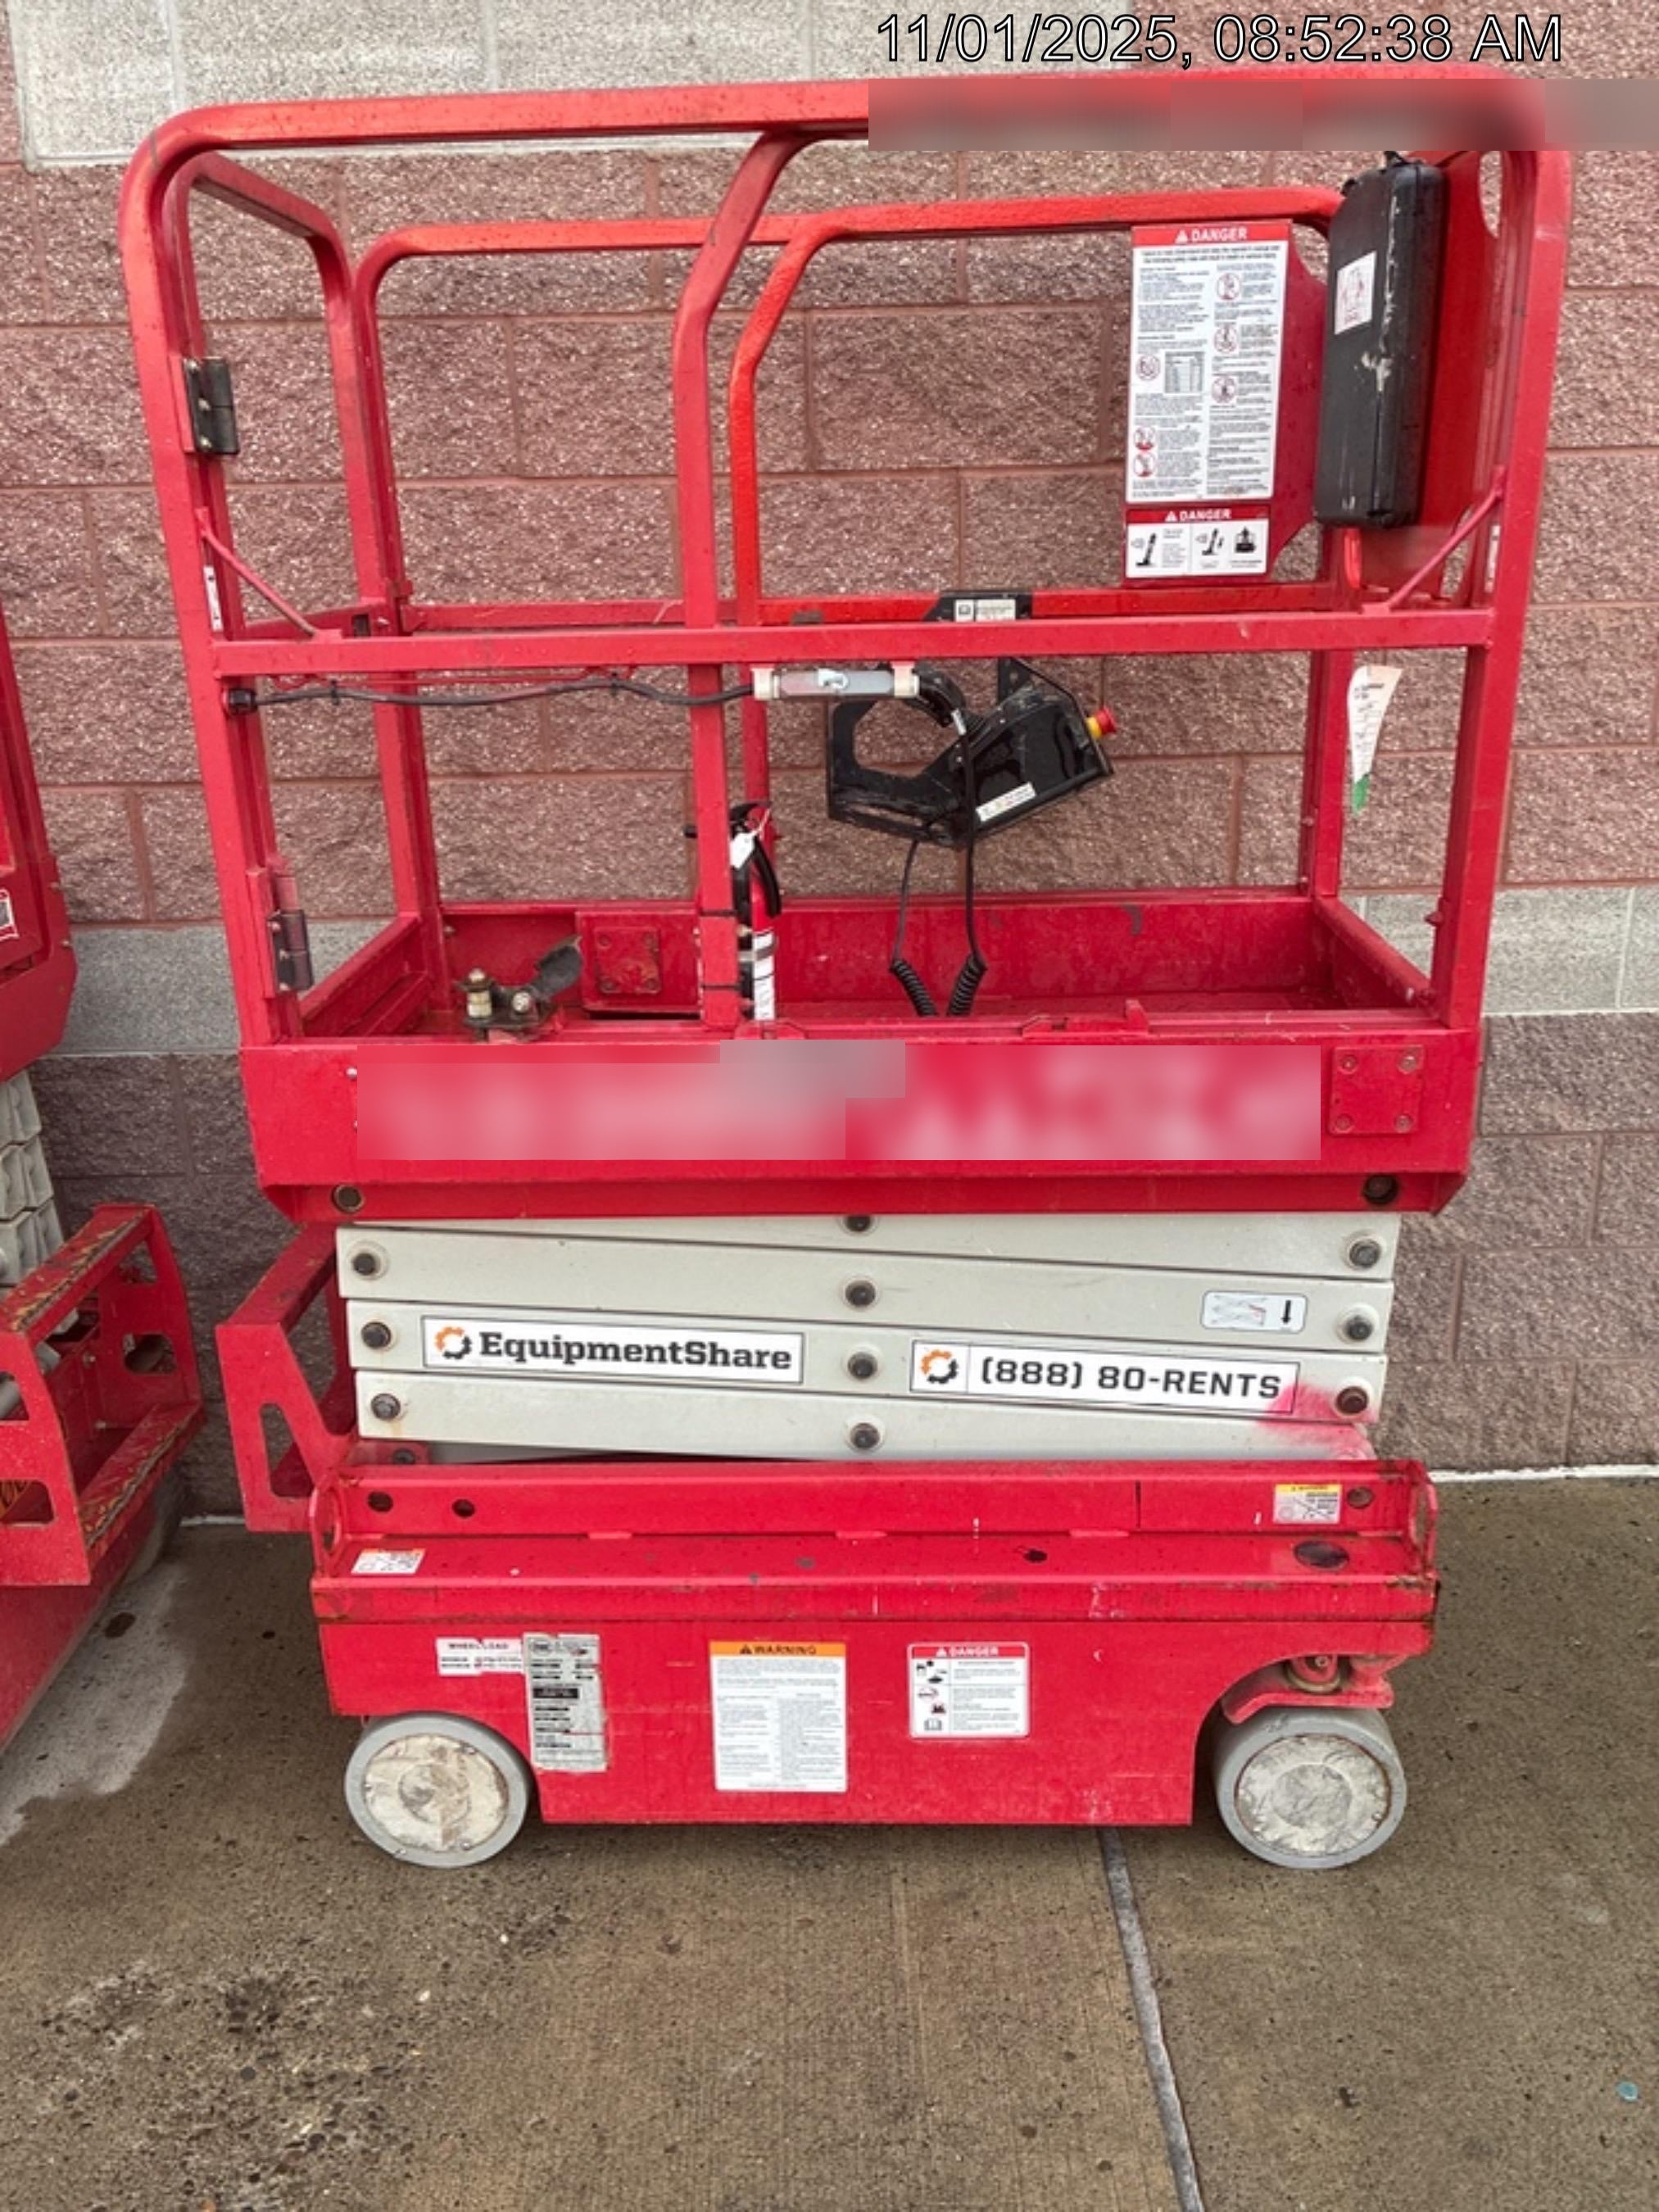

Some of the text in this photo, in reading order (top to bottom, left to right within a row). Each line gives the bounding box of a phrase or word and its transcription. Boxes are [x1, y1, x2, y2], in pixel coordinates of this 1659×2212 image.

[1191, 227, 1248, 243] DANGER
[1179, 508, 1232, 522] DANGER
[479, 1331, 792, 1370] EquipmentShare
[981, 1357, 1281, 1398] (888) 80-RENTS
[754, 1645, 817, 1655] WARNING
